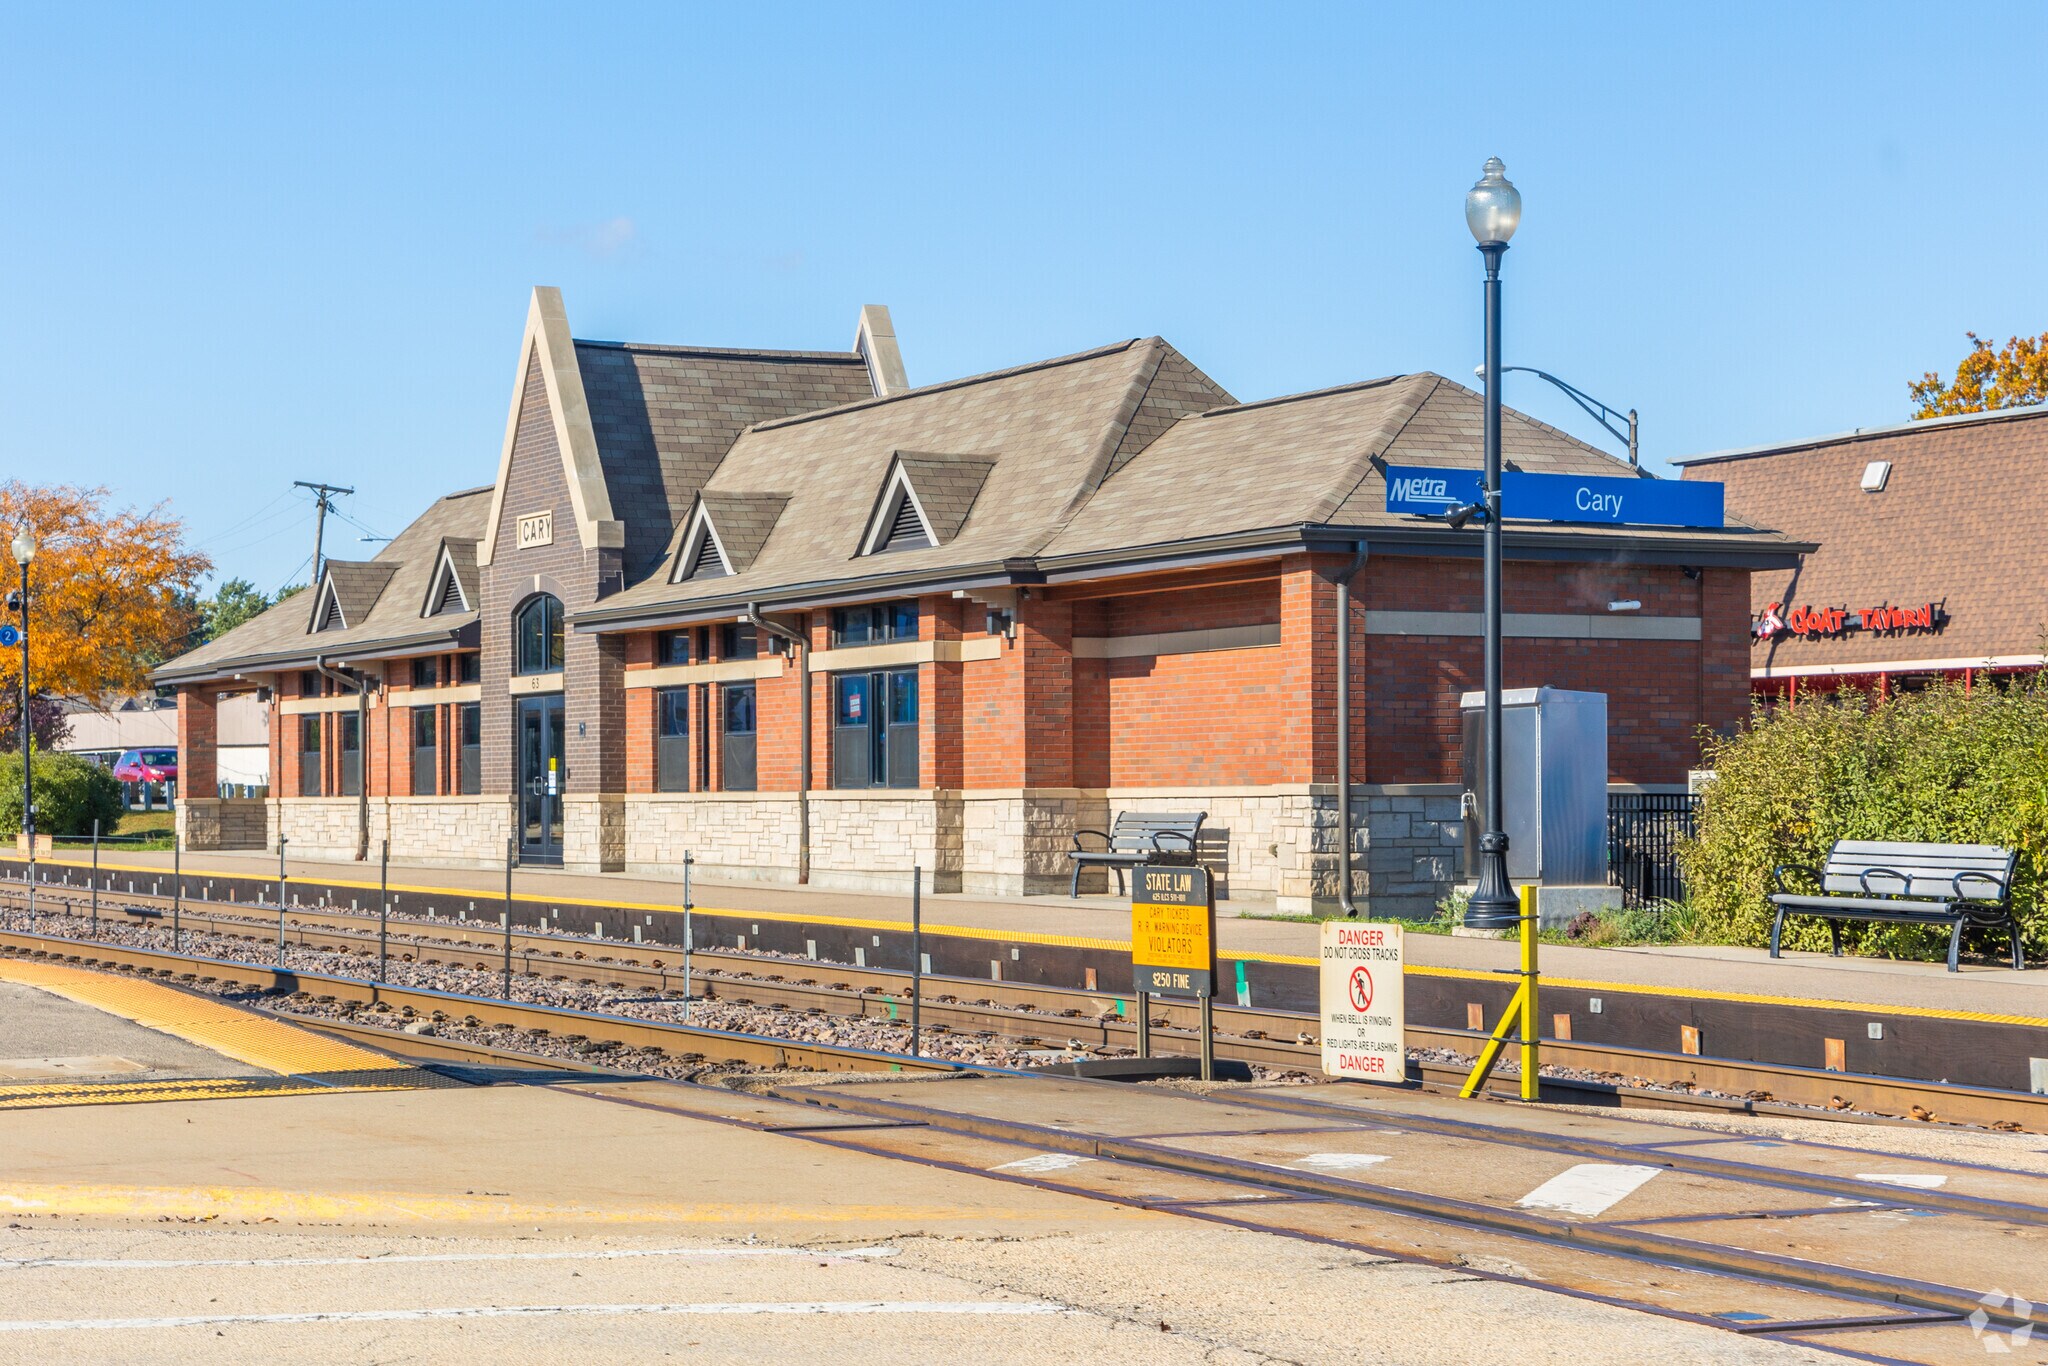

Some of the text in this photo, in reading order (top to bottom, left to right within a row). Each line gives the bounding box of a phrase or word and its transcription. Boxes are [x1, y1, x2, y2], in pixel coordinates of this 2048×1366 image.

[1389, 477, 1447, 502] Metra
[1576, 487, 1623, 518] Cary
[523, 517, 551, 542] CARY
[1790, 603, 1931, 635] GOAT TAVERN
[4, 630, 11, 641] 2
[531, 677, 540, 690] 63
[1145, 873, 1192, 892] STATE LAW
[1149, 906, 1190, 920] CARY TICKETS
[1154, 922, 1180, 935] WARNING
[1182, 923, 1203, 936] DEVICE
[1339, 929, 1384, 946] DANGER
[1148, 936, 1193, 954] VIOLATORS
[1324, 946, 1398, 961] DO NOT CROSS TRACKS
[1152, 972, 1190, 989] $250 FINE
[1331, 1013, 1392, 1026] WHEN BELL IS RINGING
[1357, 1028, 1366, 1037] OR
[1327, 1038, 1398, 1053] RED LIGHTS ARE FLASHING
[1340, 1054, 1385, 1073] DANGER
